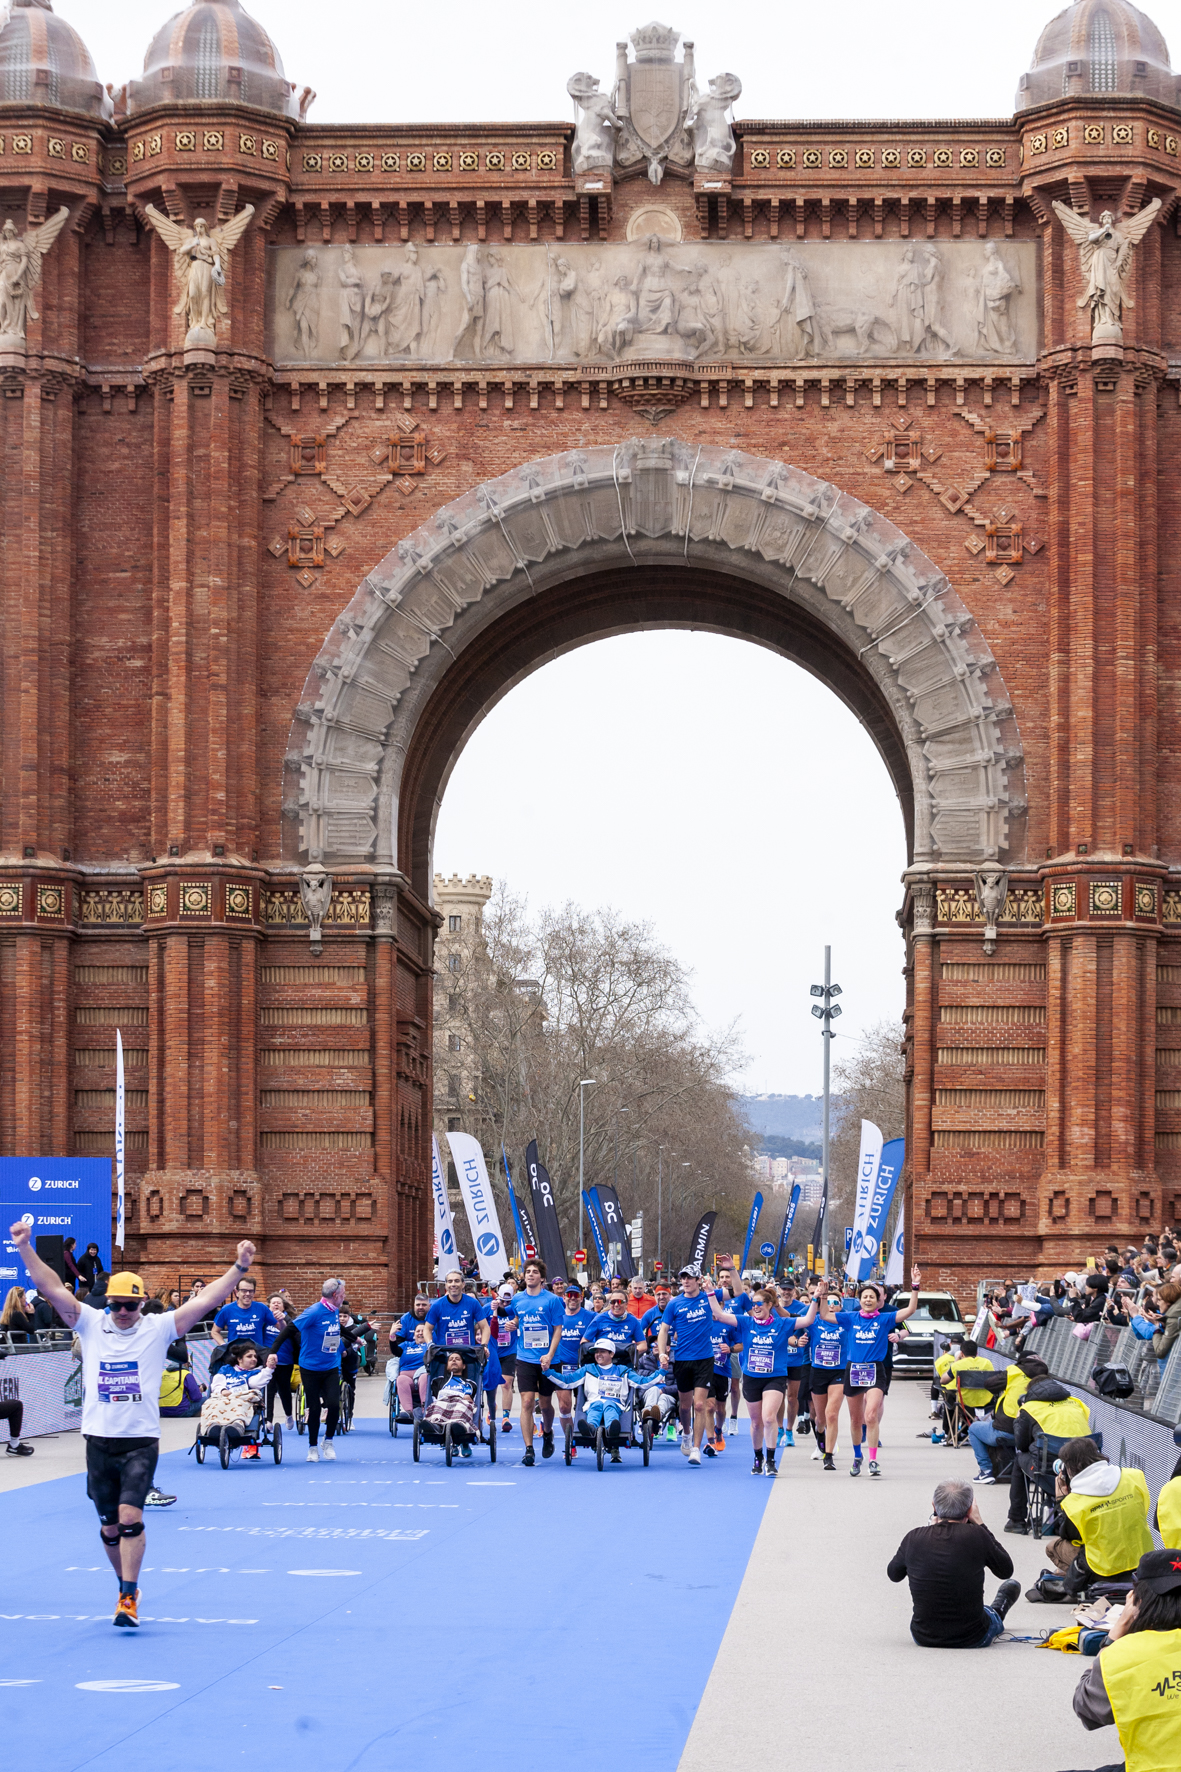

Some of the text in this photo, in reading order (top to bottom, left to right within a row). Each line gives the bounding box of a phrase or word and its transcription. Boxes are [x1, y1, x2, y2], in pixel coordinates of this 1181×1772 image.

[44, 1180, 79, 1189] ZURICH
[867, 1164, 895, 1229] ZURICH
[37, 1216, 71, 1225] ZURICH
[104, 1375, 140, 1385] CAPITANO
[1089, 1502, 1105, 1514] RPM
[1110, 1493, 1134, 1505] SPORTS
[64, 1566, 273, 1574] ZURIH
